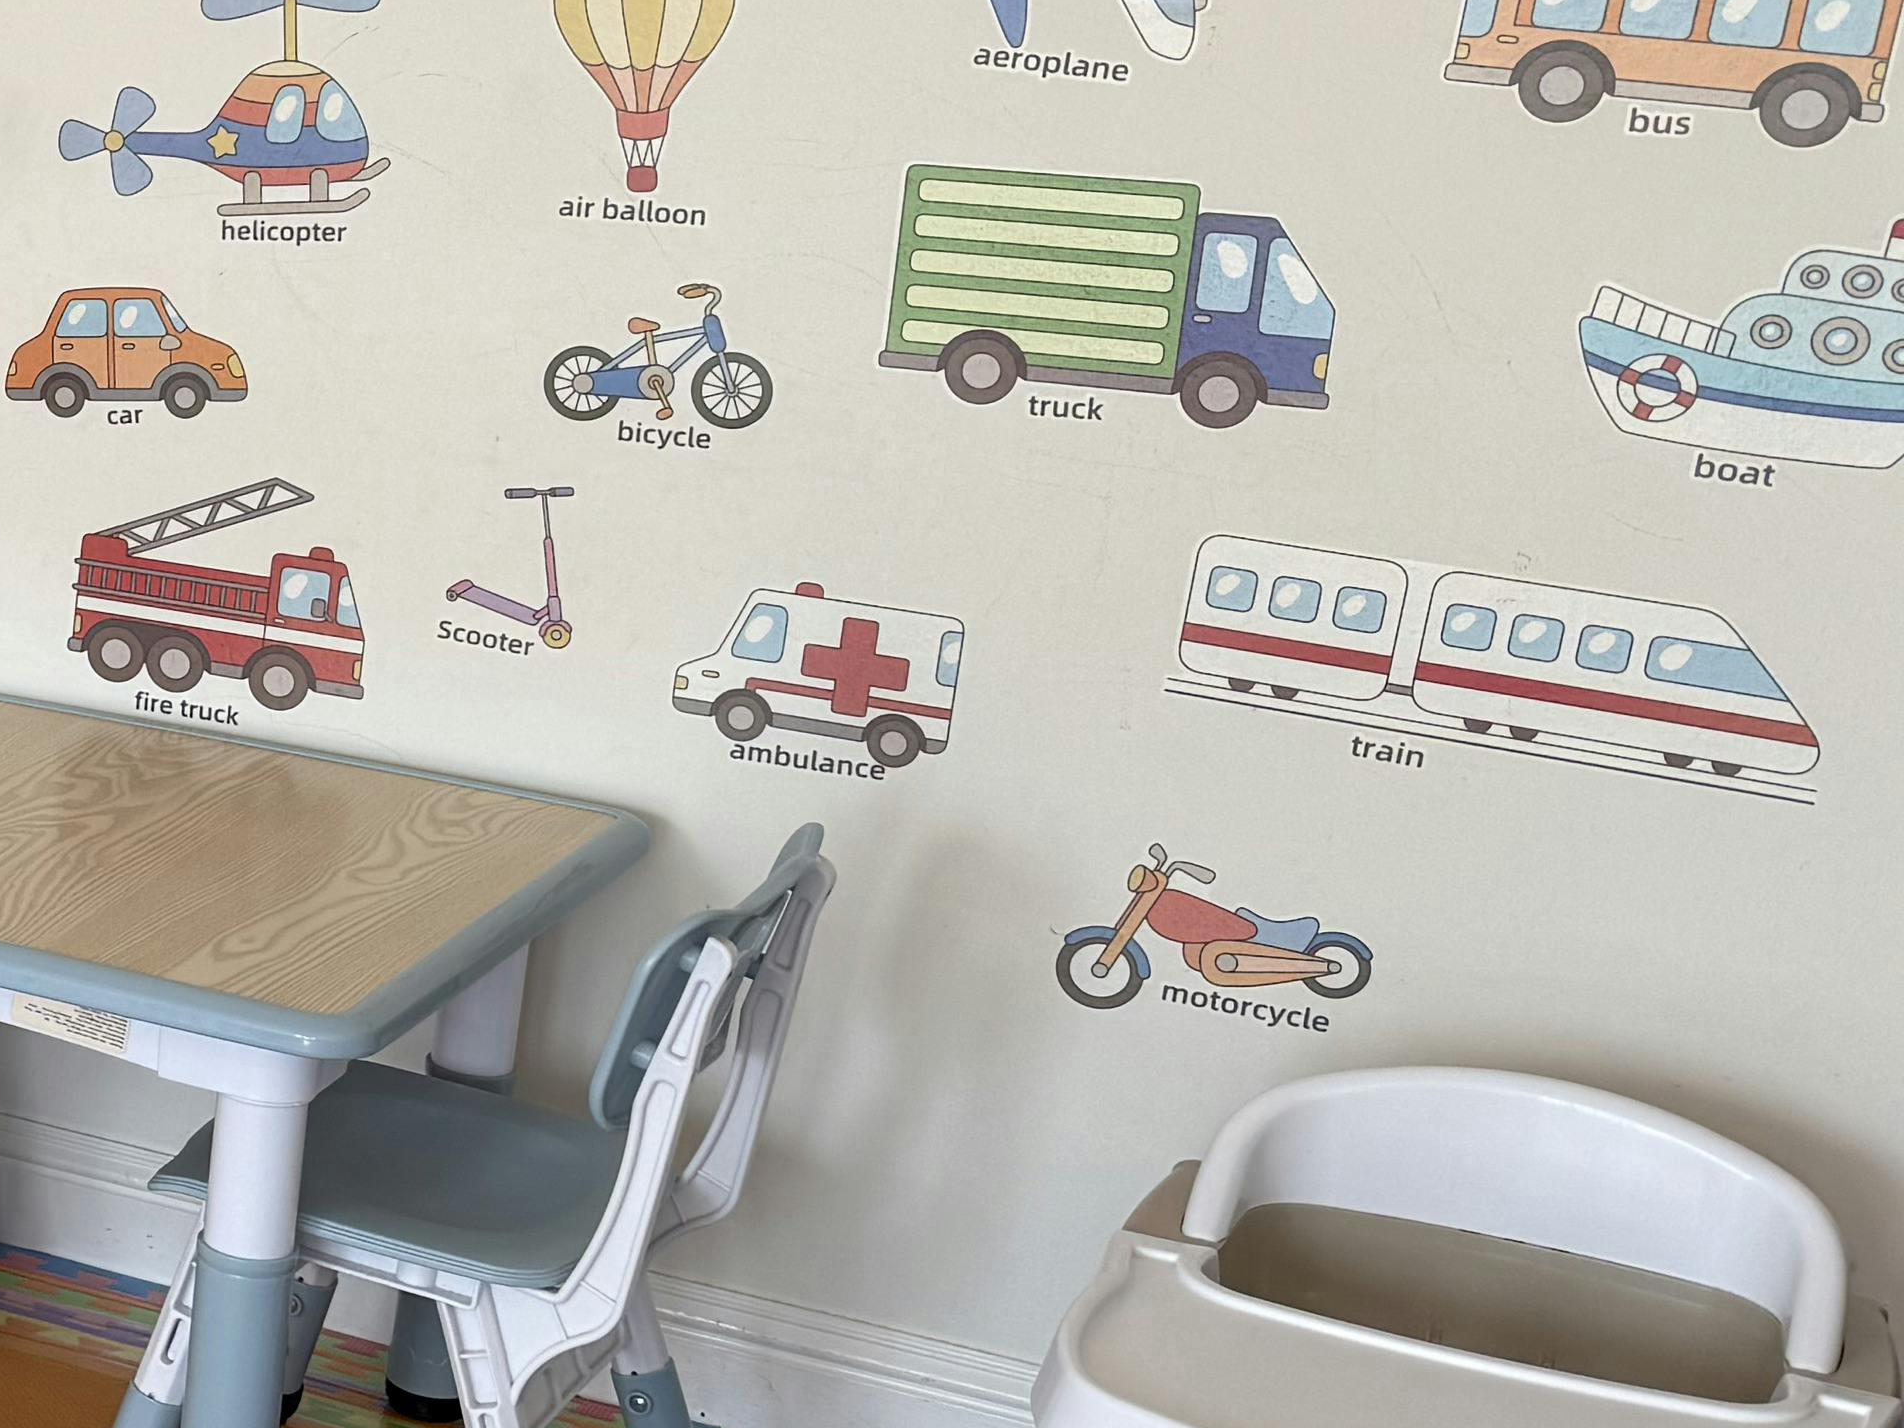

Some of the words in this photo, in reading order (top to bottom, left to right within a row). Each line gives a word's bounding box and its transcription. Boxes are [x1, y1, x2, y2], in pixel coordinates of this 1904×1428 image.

[973, 46, 1129, 82] aeroplane
[1628, 108, 1691, 136] bus
[558, 196, 595, 219] air
[602, 198, 706, 226] balloon
[220, 219, 347, 247] helicopter
[107, 406, 143, 425] car
[1028, 396, 1104, 421] truck
[617, 420, 711, 450] bicycle
[1693, 454, 1776, 487] boat
[437, 620, 534, 657] Scooter
[135, 690, 173, 716] fire
[180, 697, 240, 726] truck
[728, 743, 886, 781] ambulance
[1351, 735, 1425, 768] train
[1161, 983, 1330, 1034] motorcycle
